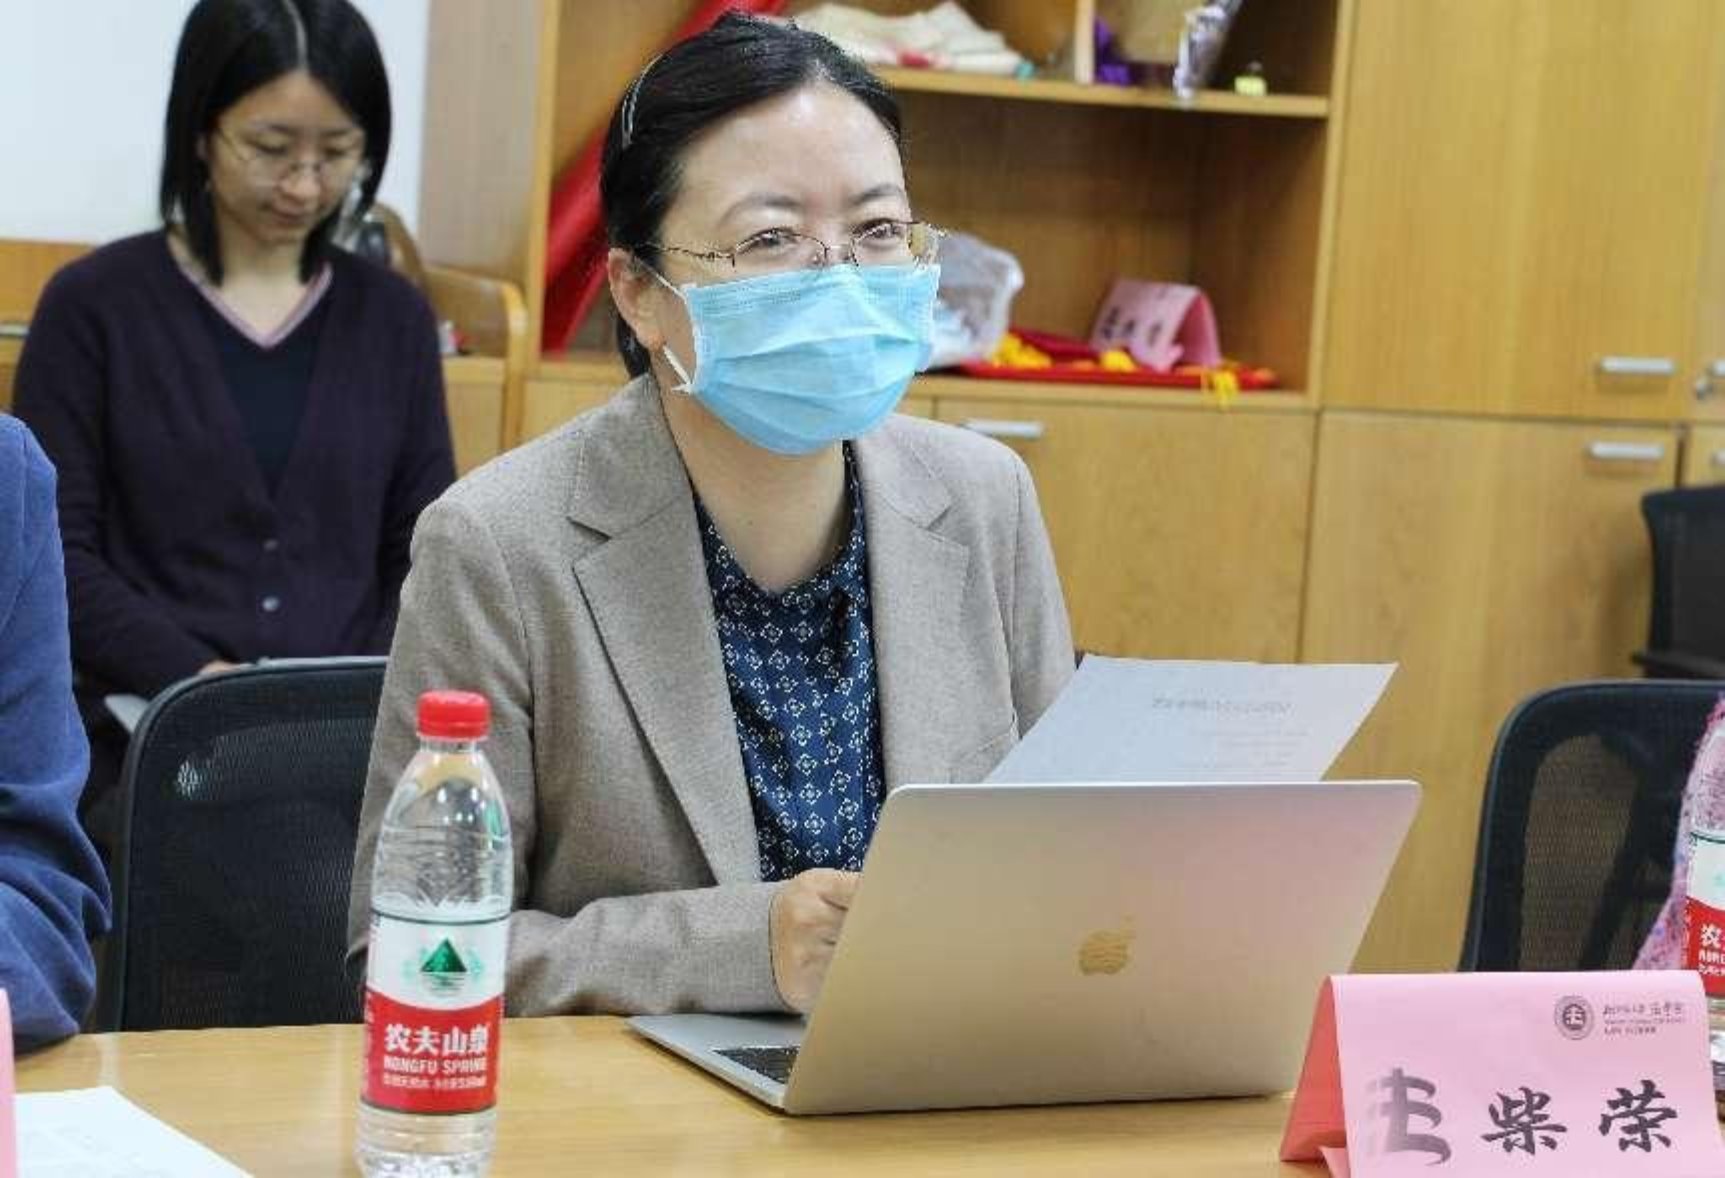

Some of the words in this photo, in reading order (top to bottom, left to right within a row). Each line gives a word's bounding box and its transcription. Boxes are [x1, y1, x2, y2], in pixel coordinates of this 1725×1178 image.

[1700, 923, 1725, 948] 农
[384, 1023, 488, 1056] 农夫山泉
[383, 1054, 437, 1074] NONGFU
[1481, 1080, 1678, 1156] 柴荣
